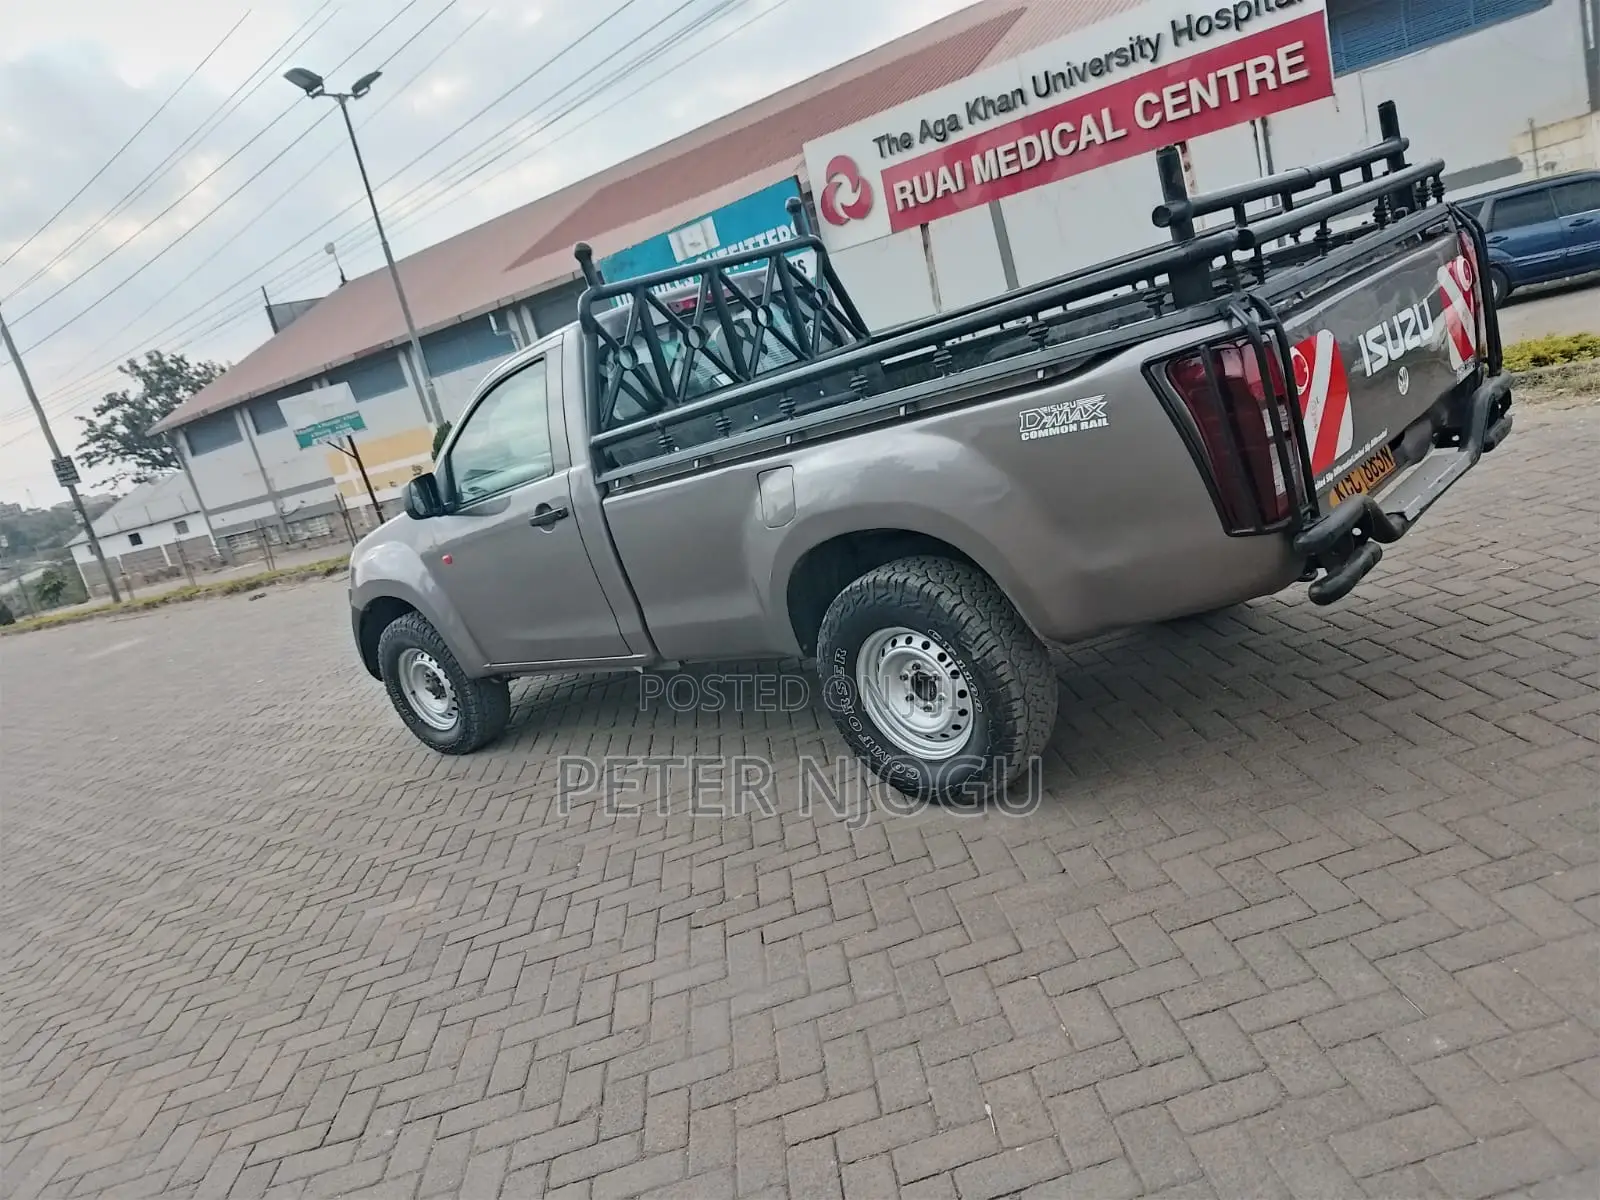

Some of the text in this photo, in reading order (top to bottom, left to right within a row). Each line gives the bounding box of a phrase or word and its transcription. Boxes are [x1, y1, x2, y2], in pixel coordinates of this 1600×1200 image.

[872, 0, 1304, 159] The Aga Khan University Hospita
[892, 40, 1310, 213] RUAI MEDICAL CENTRE
[1357, 297, 1434, 378] ISUZU
[1021, 417, 1110, 441] COMMON RAIL
[1047, 400, 1078, 413] ISUZU
[832, 647, 922, 781] COMFORSER
